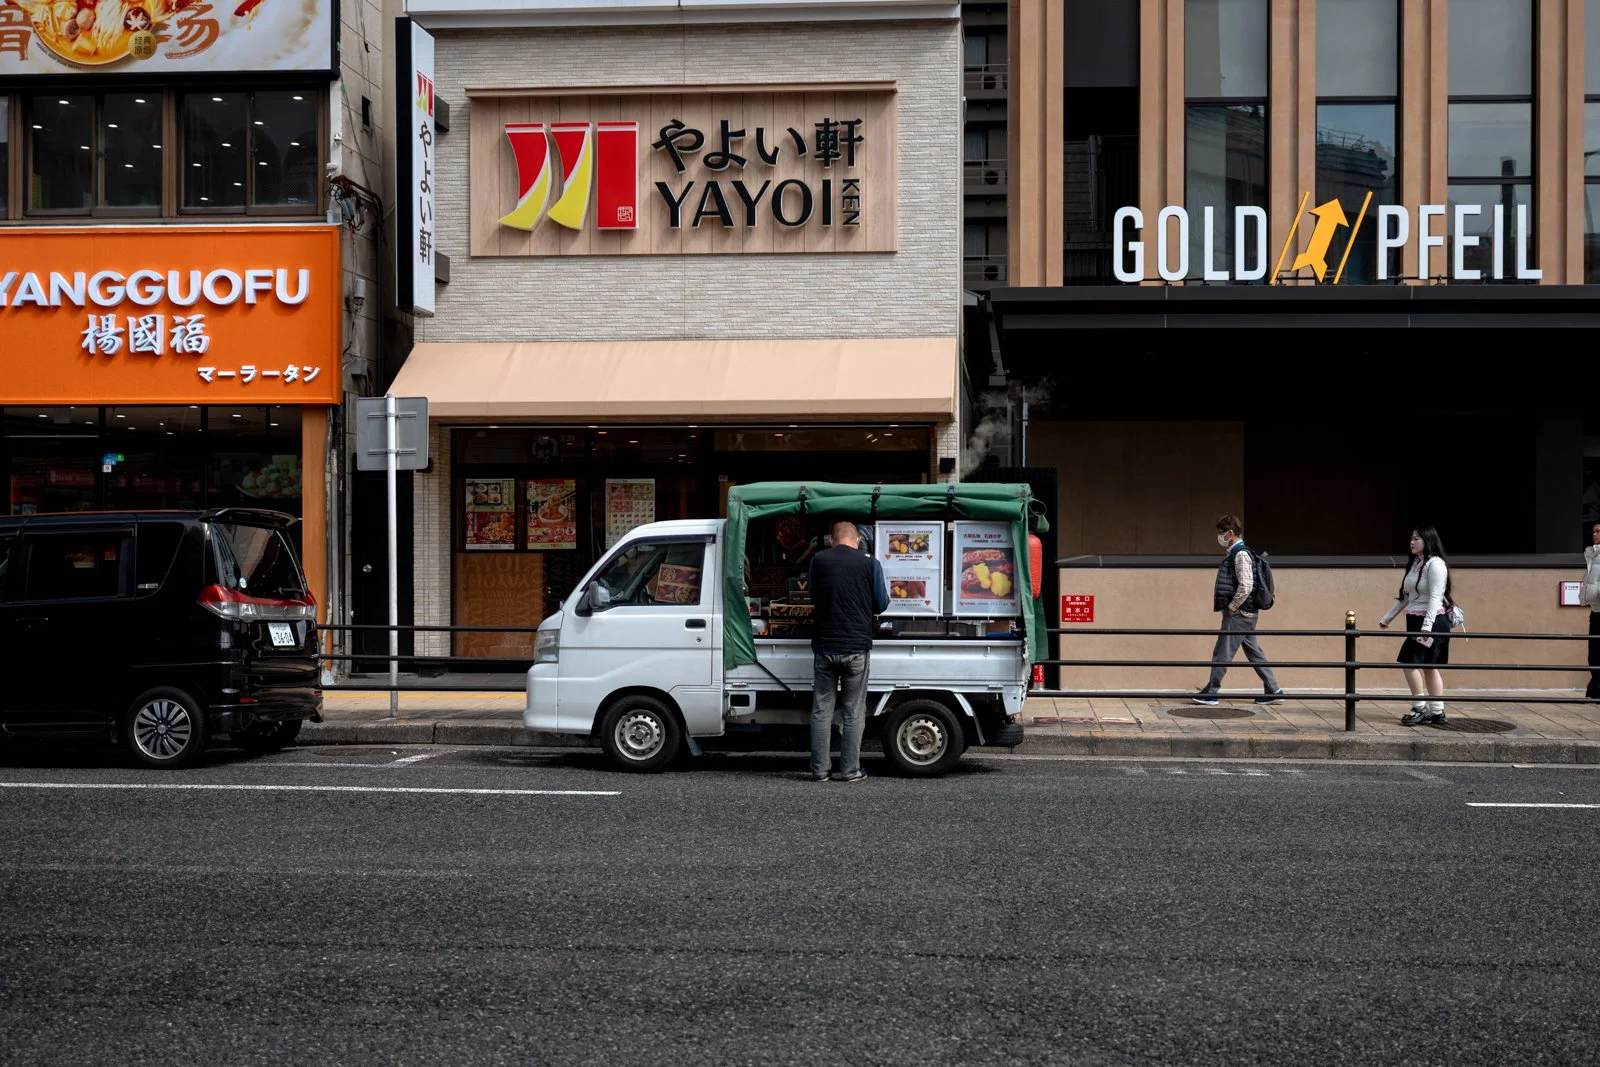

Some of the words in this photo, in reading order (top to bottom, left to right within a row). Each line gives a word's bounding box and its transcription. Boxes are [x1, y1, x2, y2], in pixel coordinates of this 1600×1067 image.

[650, 118, 864, 173] やよい軒
[417, 120, 433, 266] やよい軒
[655, 178, 832, 228] YAYOI
[841, 178, 860, 226] KEN
[1113, 205, 1268, 283] GOLD
[1377, 204, 1543, 280] PFEIL
[80, 313, 211, 357] 楊國福
[197, 364, 321, 384] マーラータン
